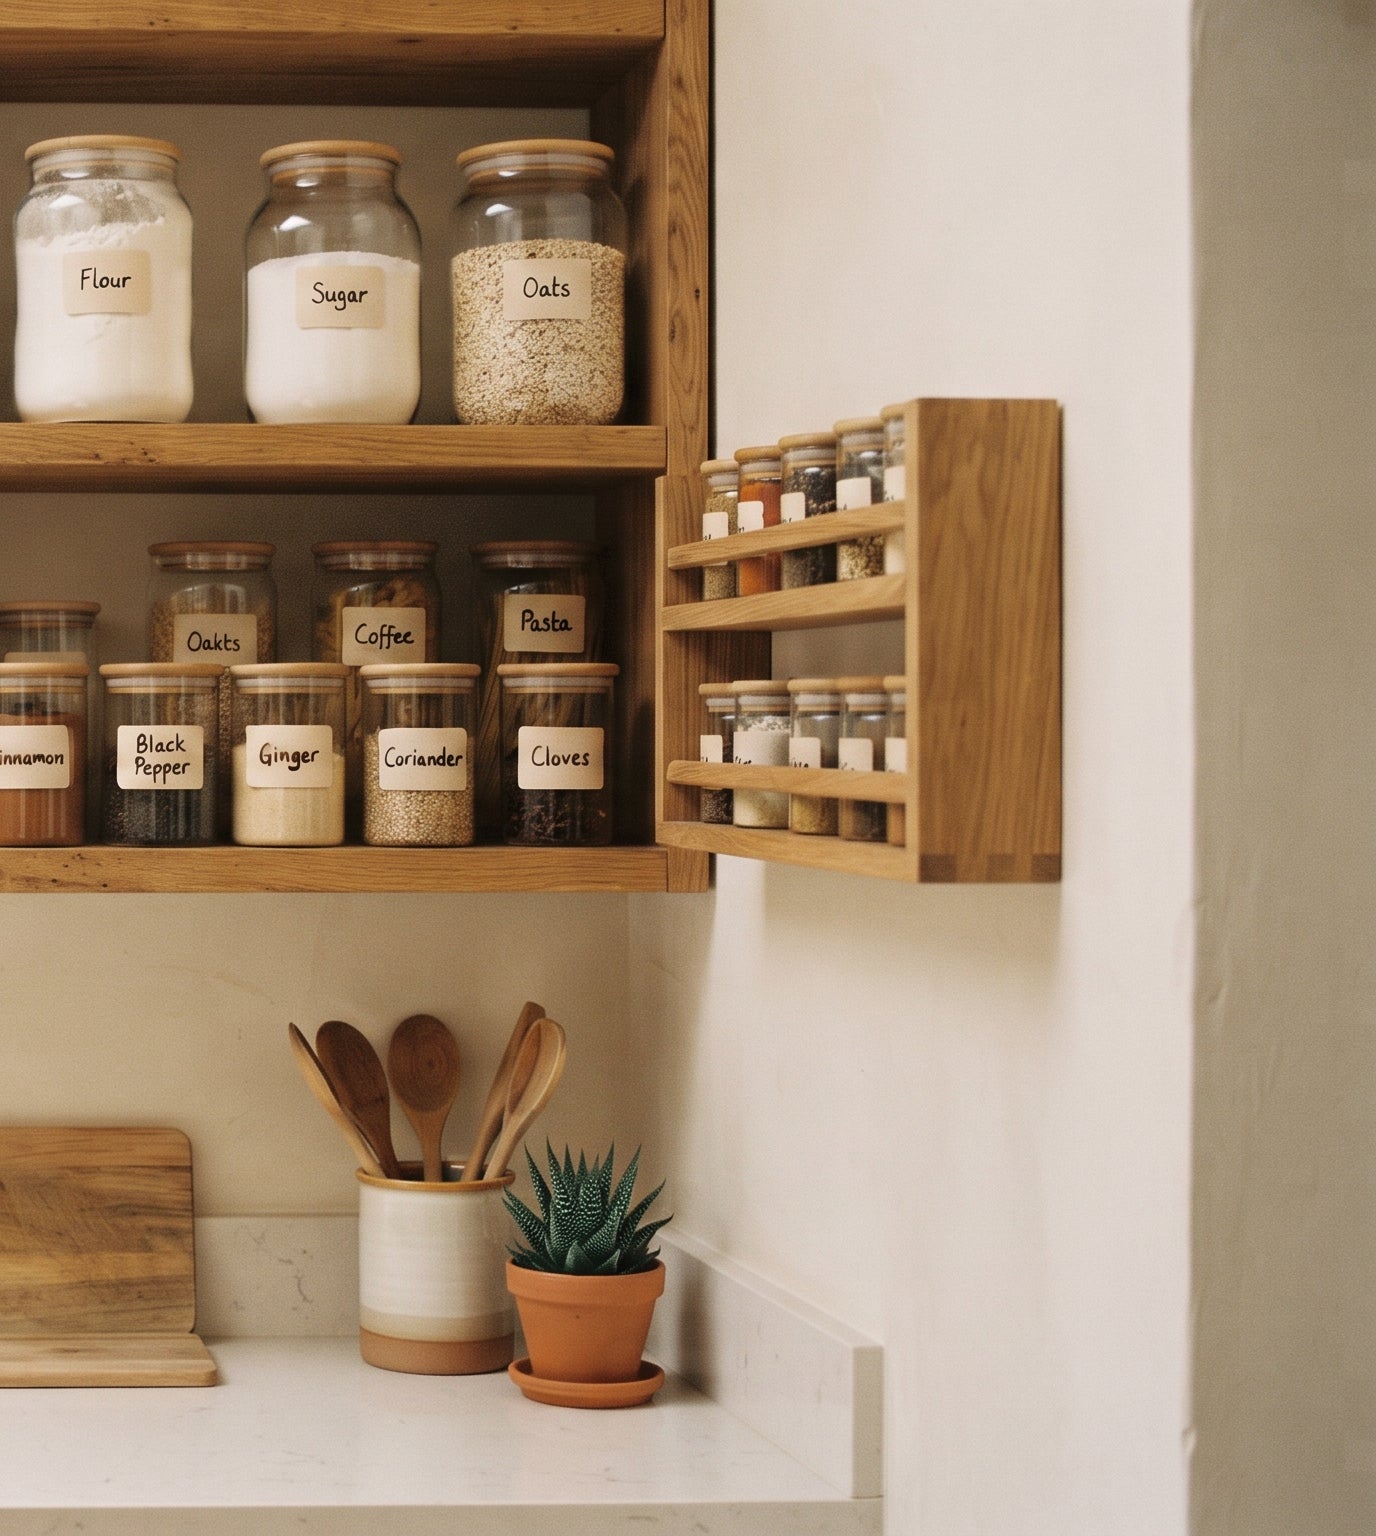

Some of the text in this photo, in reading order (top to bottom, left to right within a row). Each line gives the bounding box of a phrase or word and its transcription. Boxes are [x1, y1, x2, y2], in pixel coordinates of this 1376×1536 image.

[80, 267, 132, 291] Flour
[523, 275, 571, 299] Oats
[311, 281, 369, 312] Sugar
[521, 608, 574, 633] Pasta
[186, 630, 241, 653] Oakts
[354, 622, 415, 650] Coffee
[136, 732, 187, 754] Black
[259, 742, 320, 772] Ginger
[384, 745, 464, 768] Coriander
[531, 745, 591, 767] Cloves
[134, 755, 191, 785] Pepper
